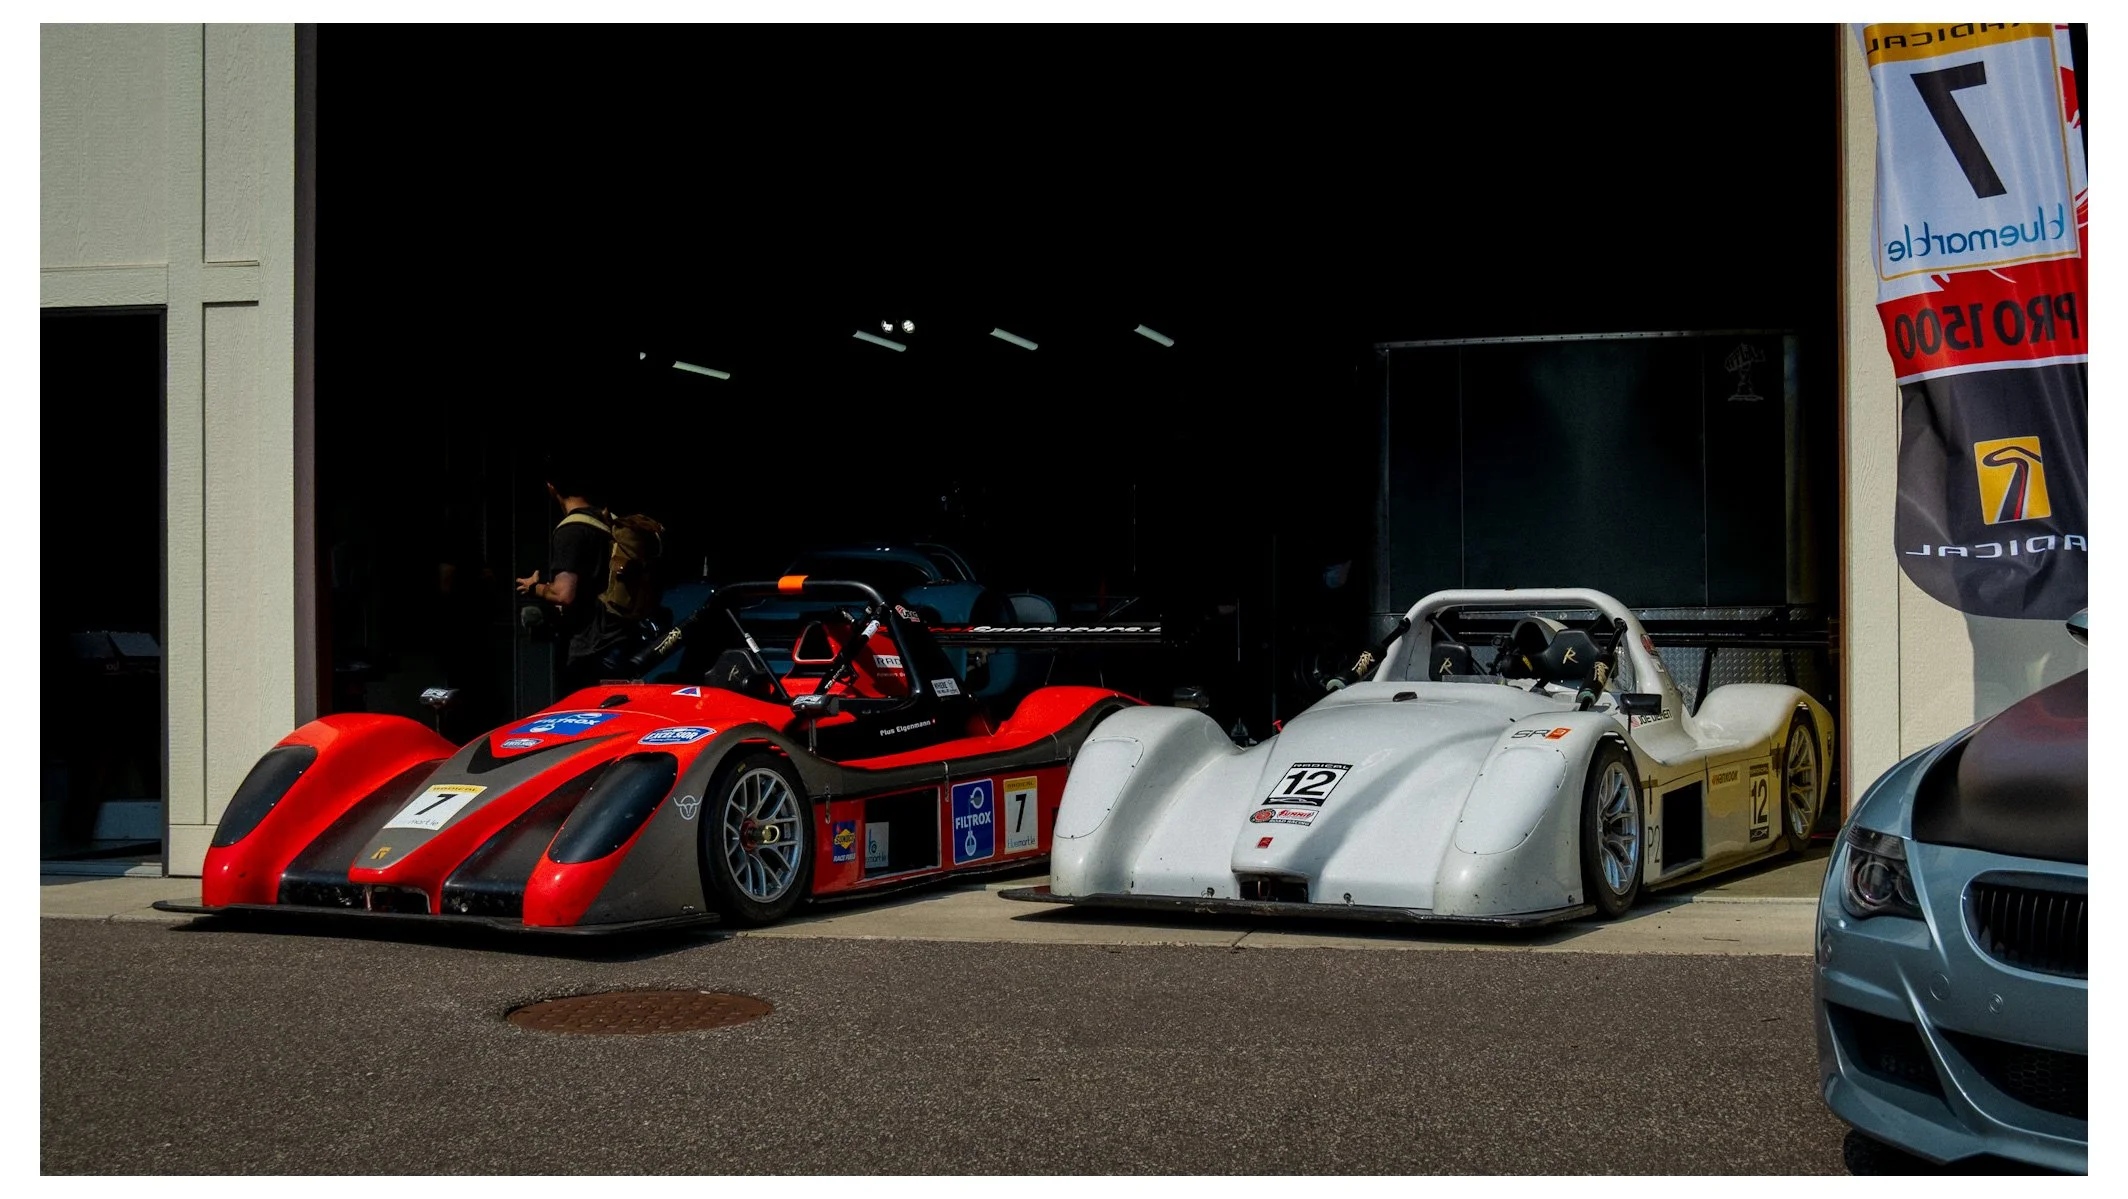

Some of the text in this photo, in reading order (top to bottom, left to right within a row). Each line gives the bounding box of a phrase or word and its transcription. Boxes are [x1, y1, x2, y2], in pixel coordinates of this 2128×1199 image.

[1282, 770, 1337, 796] 12
[414, 793, 459, 816] 7
[1015, 793, 1027, 833] 7
[1751, 778, 1768, 825] 12
[955, 811, 992, 830] FILTROX
[1647, 825, 1661, 865] P2
